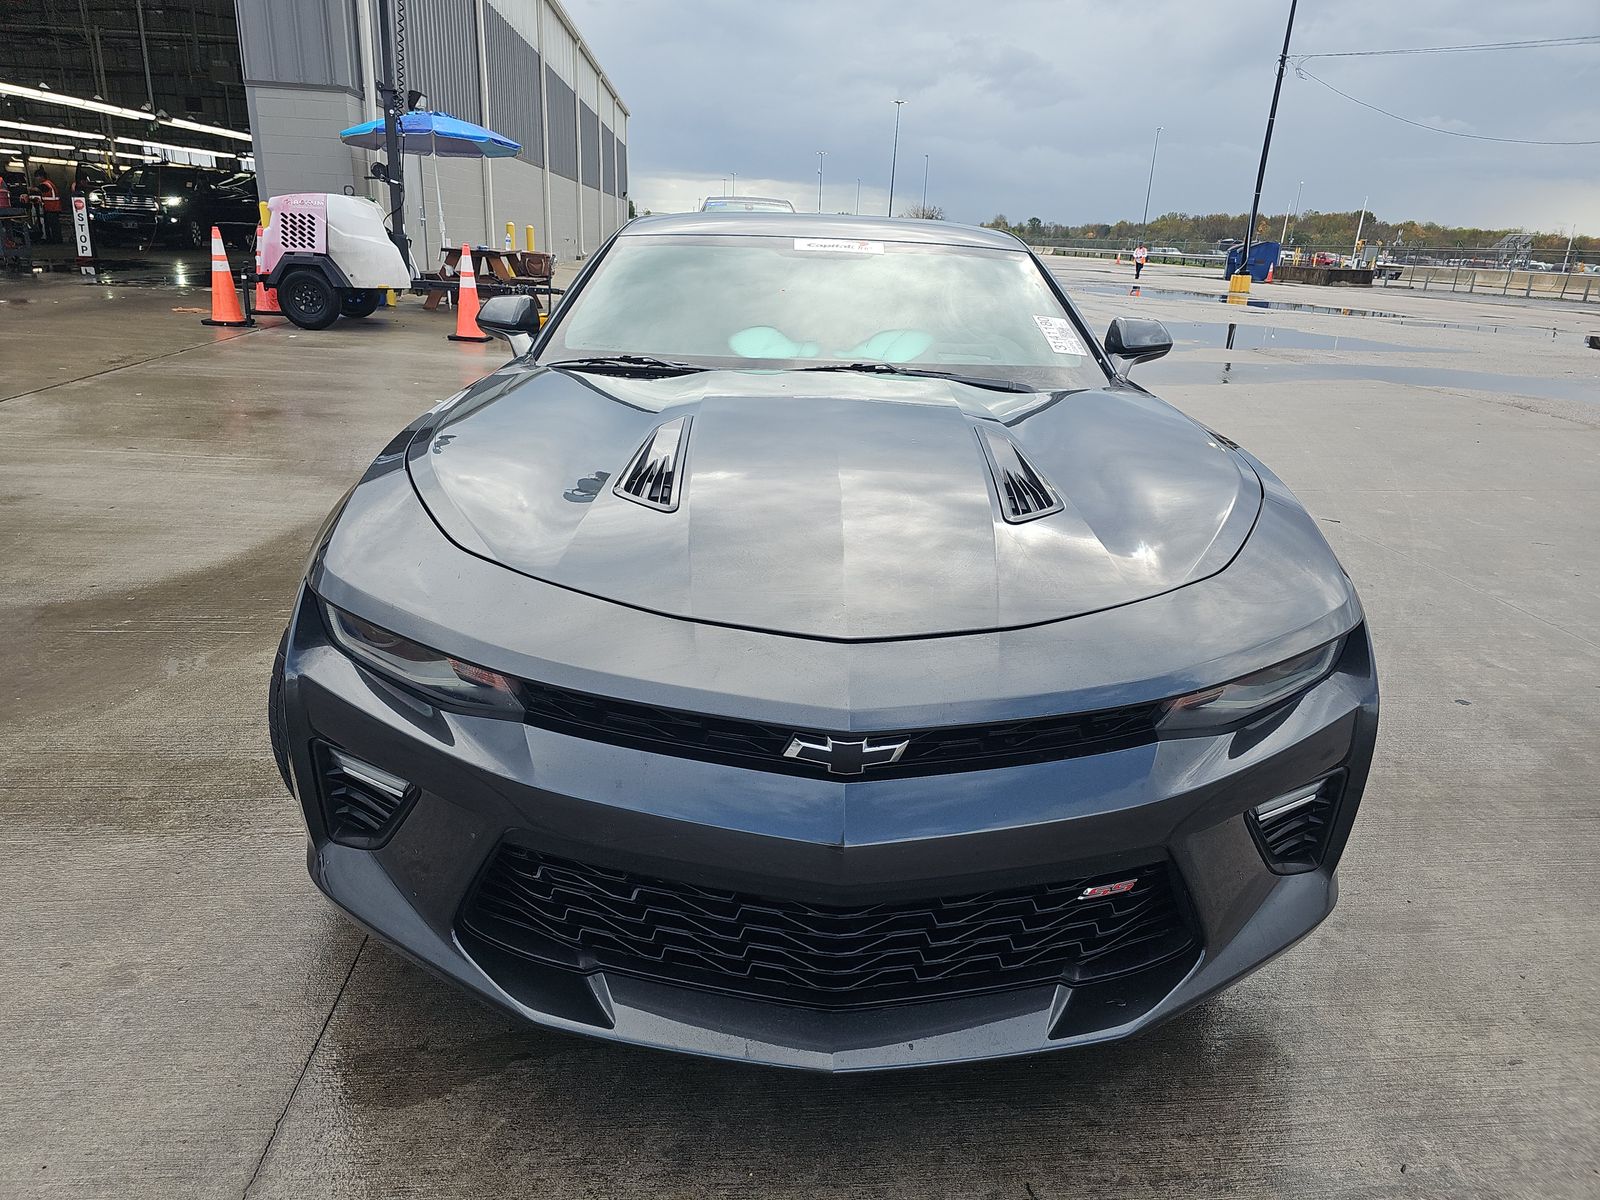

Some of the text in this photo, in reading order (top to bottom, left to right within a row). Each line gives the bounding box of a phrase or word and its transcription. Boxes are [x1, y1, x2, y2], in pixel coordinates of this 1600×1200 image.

[77, 213, 88, 254] STOP
[1037, 317, 1067, 350] 3141180
[1079, 880, 1137, 899] SS
